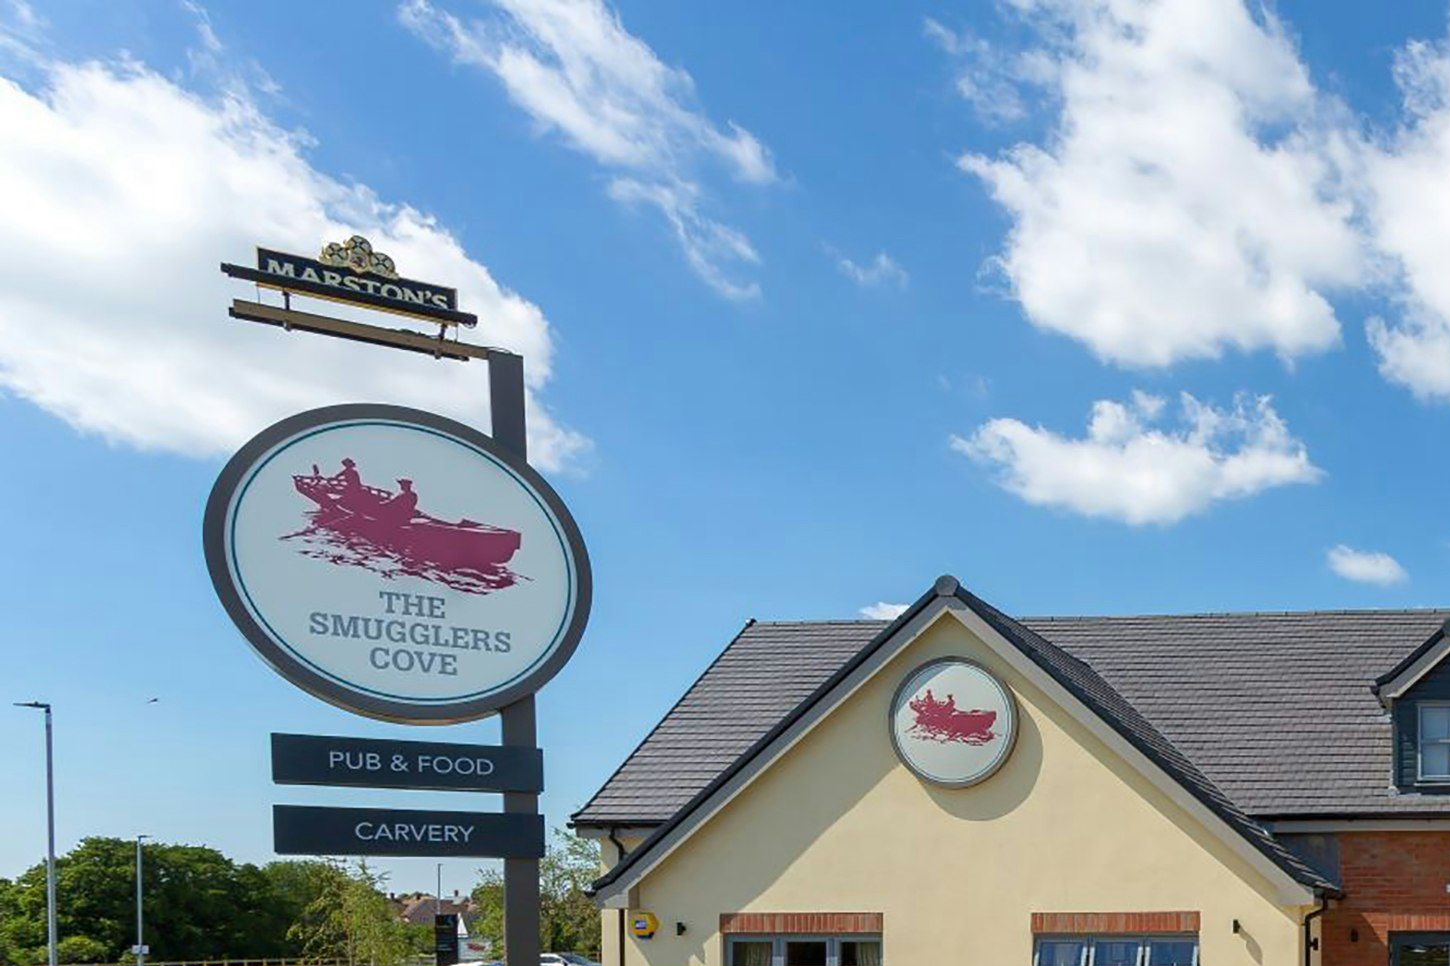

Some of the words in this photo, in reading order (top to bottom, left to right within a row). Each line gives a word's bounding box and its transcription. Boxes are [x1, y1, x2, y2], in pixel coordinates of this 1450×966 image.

[266, 258, 449, 309] MARSTON'S
[379, 591, 446, 619] THE
[309, 612, 512, 653] SMUGGLERS
[369, 647, 458, 676] COVE
[329, 751, 382, 771] PUB
[390, 754, 409, 772] &
[418, 755, 495, 775] FOOD
[355, 822, 474, 843] CARVERY
